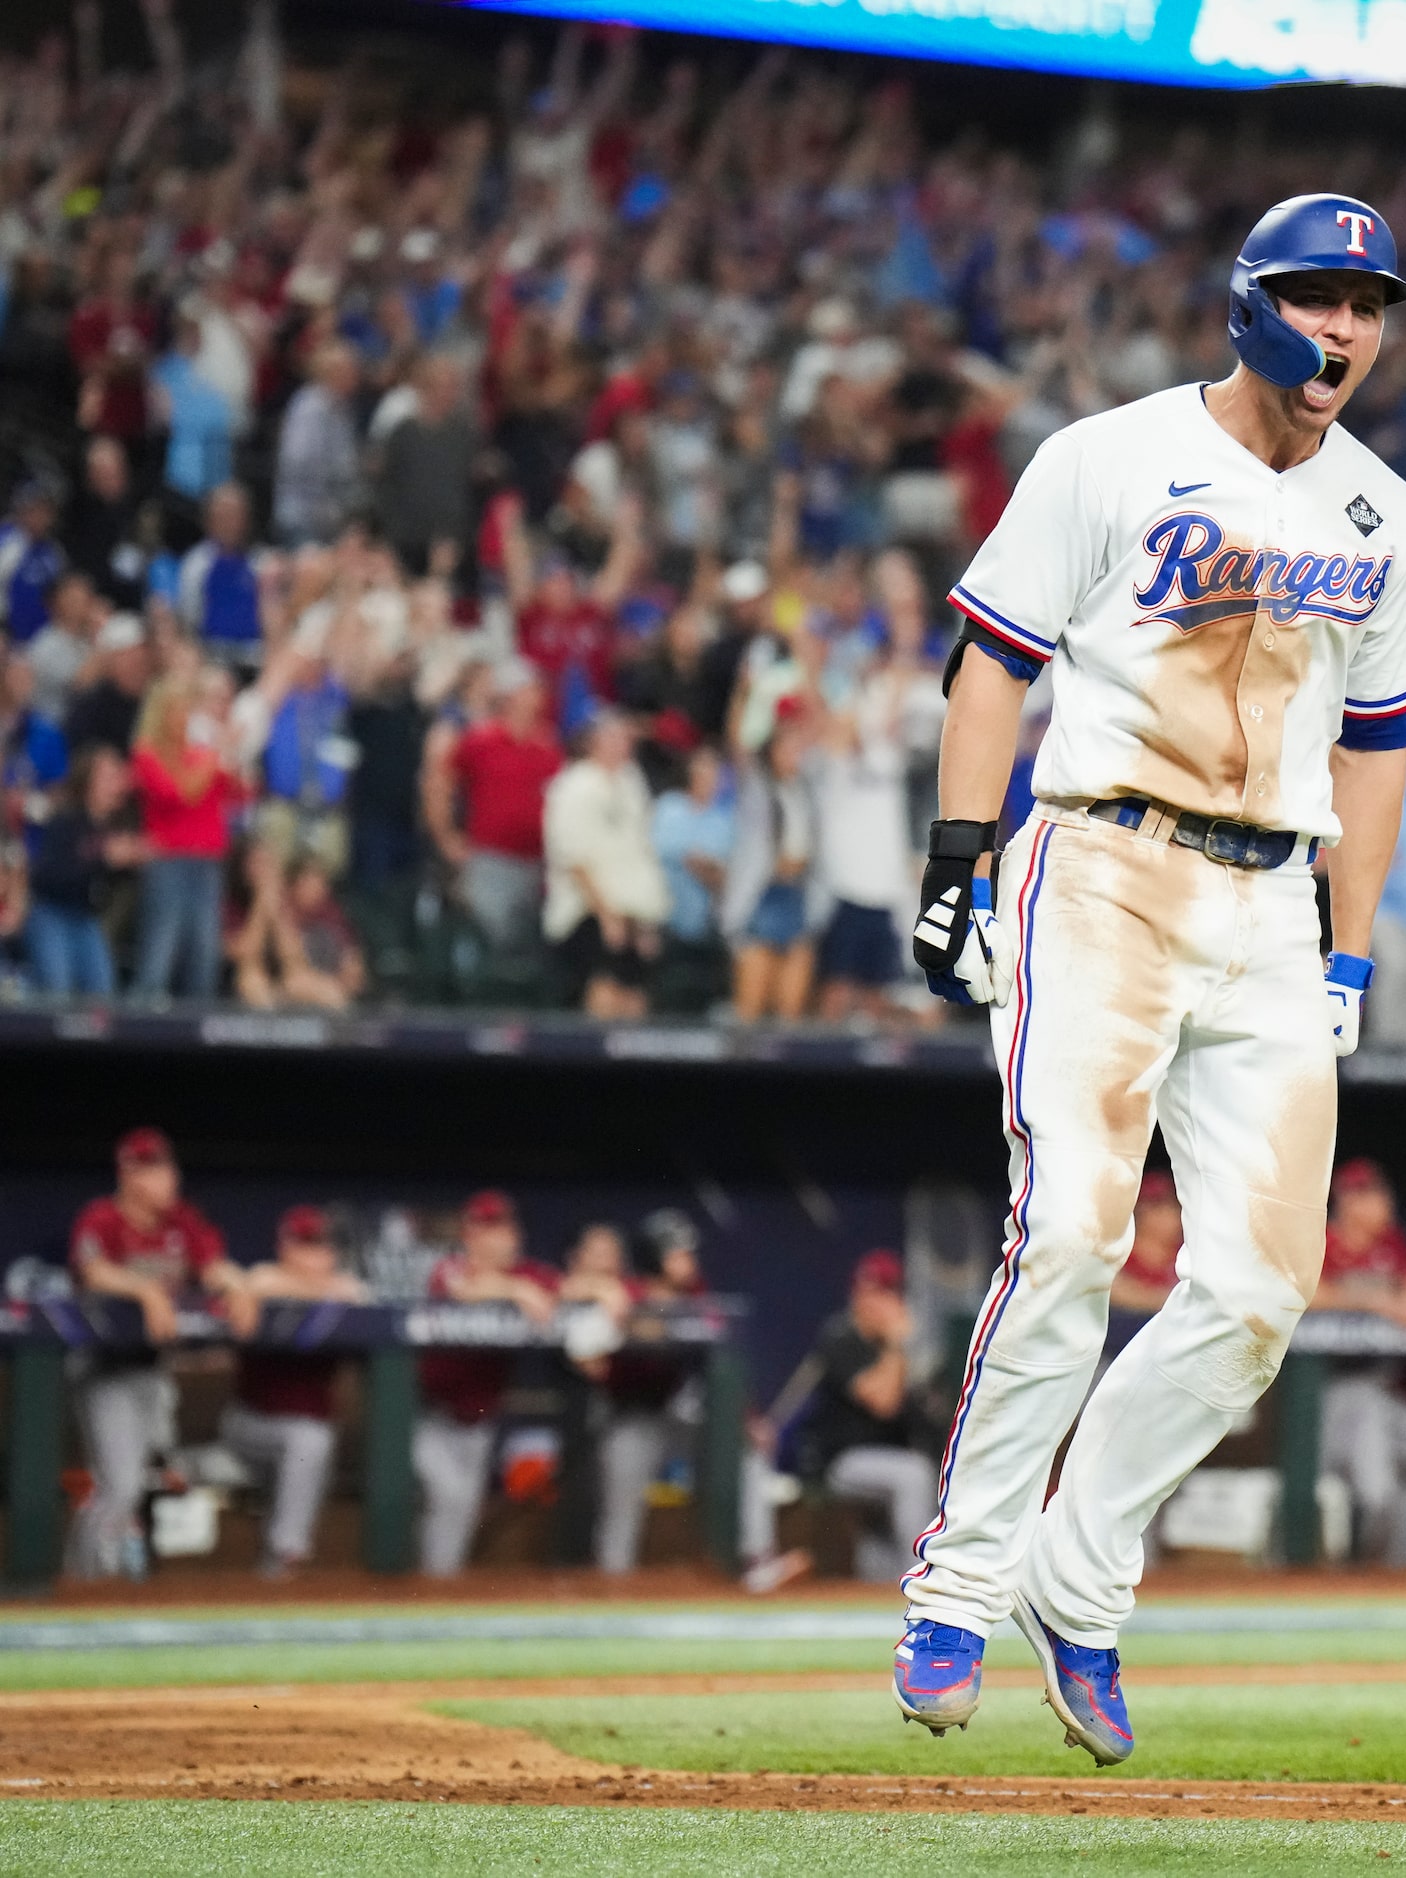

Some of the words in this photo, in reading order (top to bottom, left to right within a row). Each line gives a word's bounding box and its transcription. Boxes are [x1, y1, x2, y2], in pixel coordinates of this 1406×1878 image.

[1336, 210, 1375, 257] T
[1350, 504, 1378, 520] WORLD
[1350, 512, 1380, 528] SERIES
[1132, 510, 1393, 627] Rangers
